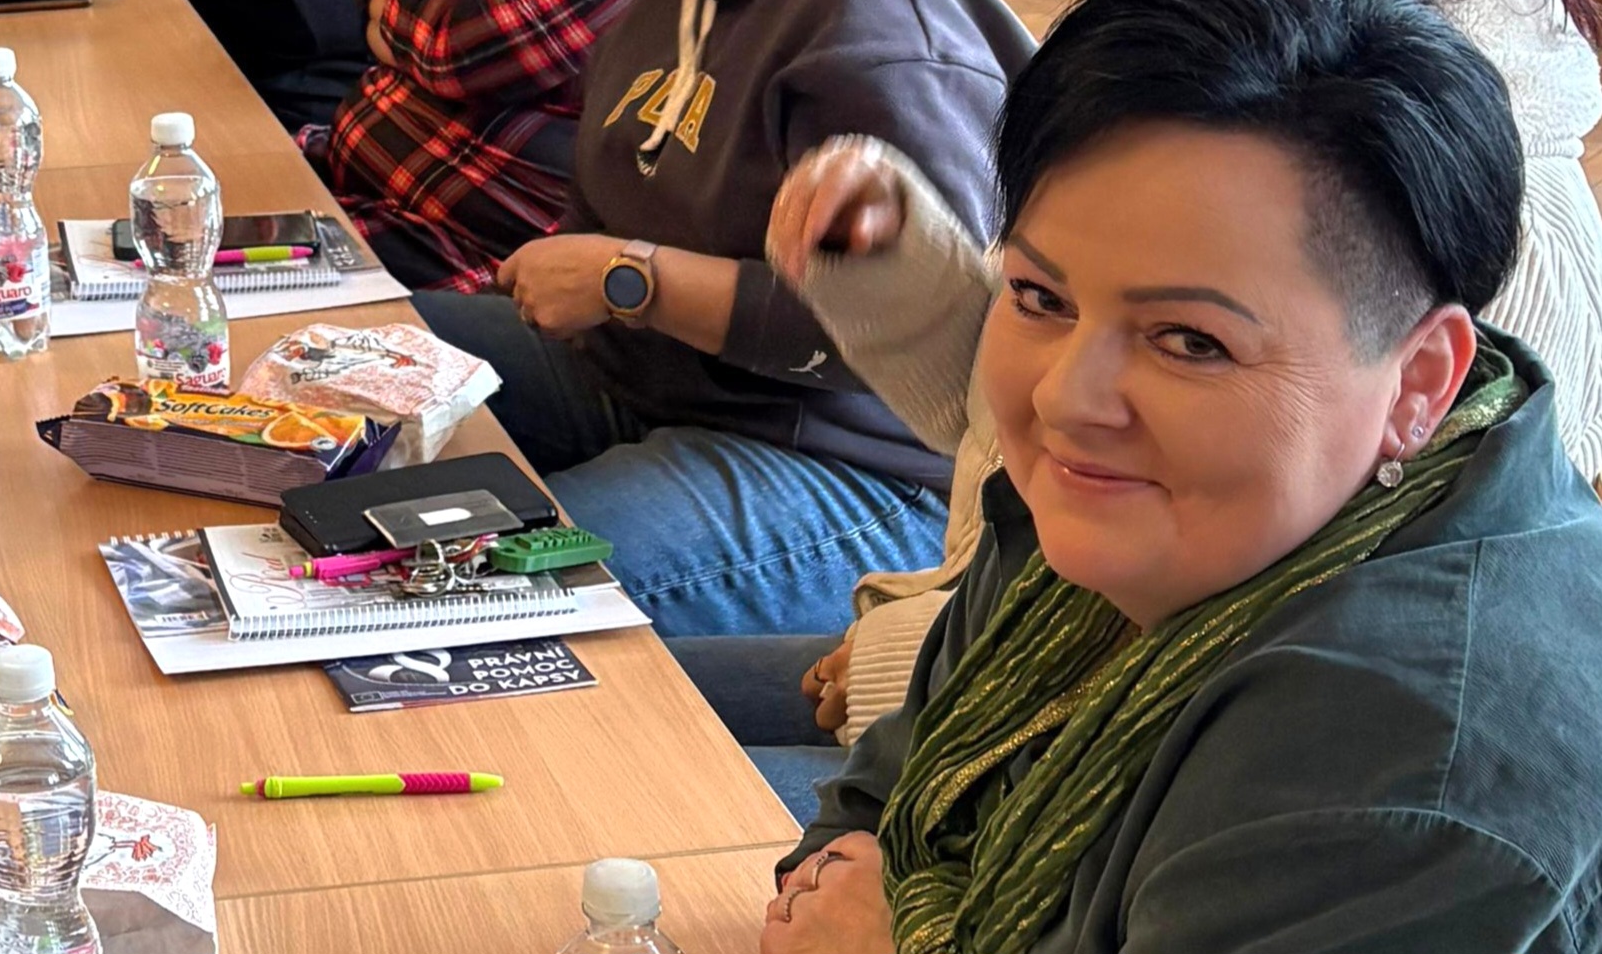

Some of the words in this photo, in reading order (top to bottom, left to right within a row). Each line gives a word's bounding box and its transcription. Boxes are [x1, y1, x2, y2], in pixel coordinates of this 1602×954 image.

[175, 367, 228, 388] Saguar
[472, 659, 575, 680] POMOC
[448, 682, 490, 695] DO
[498, 669, 580, 689] KAPSY
